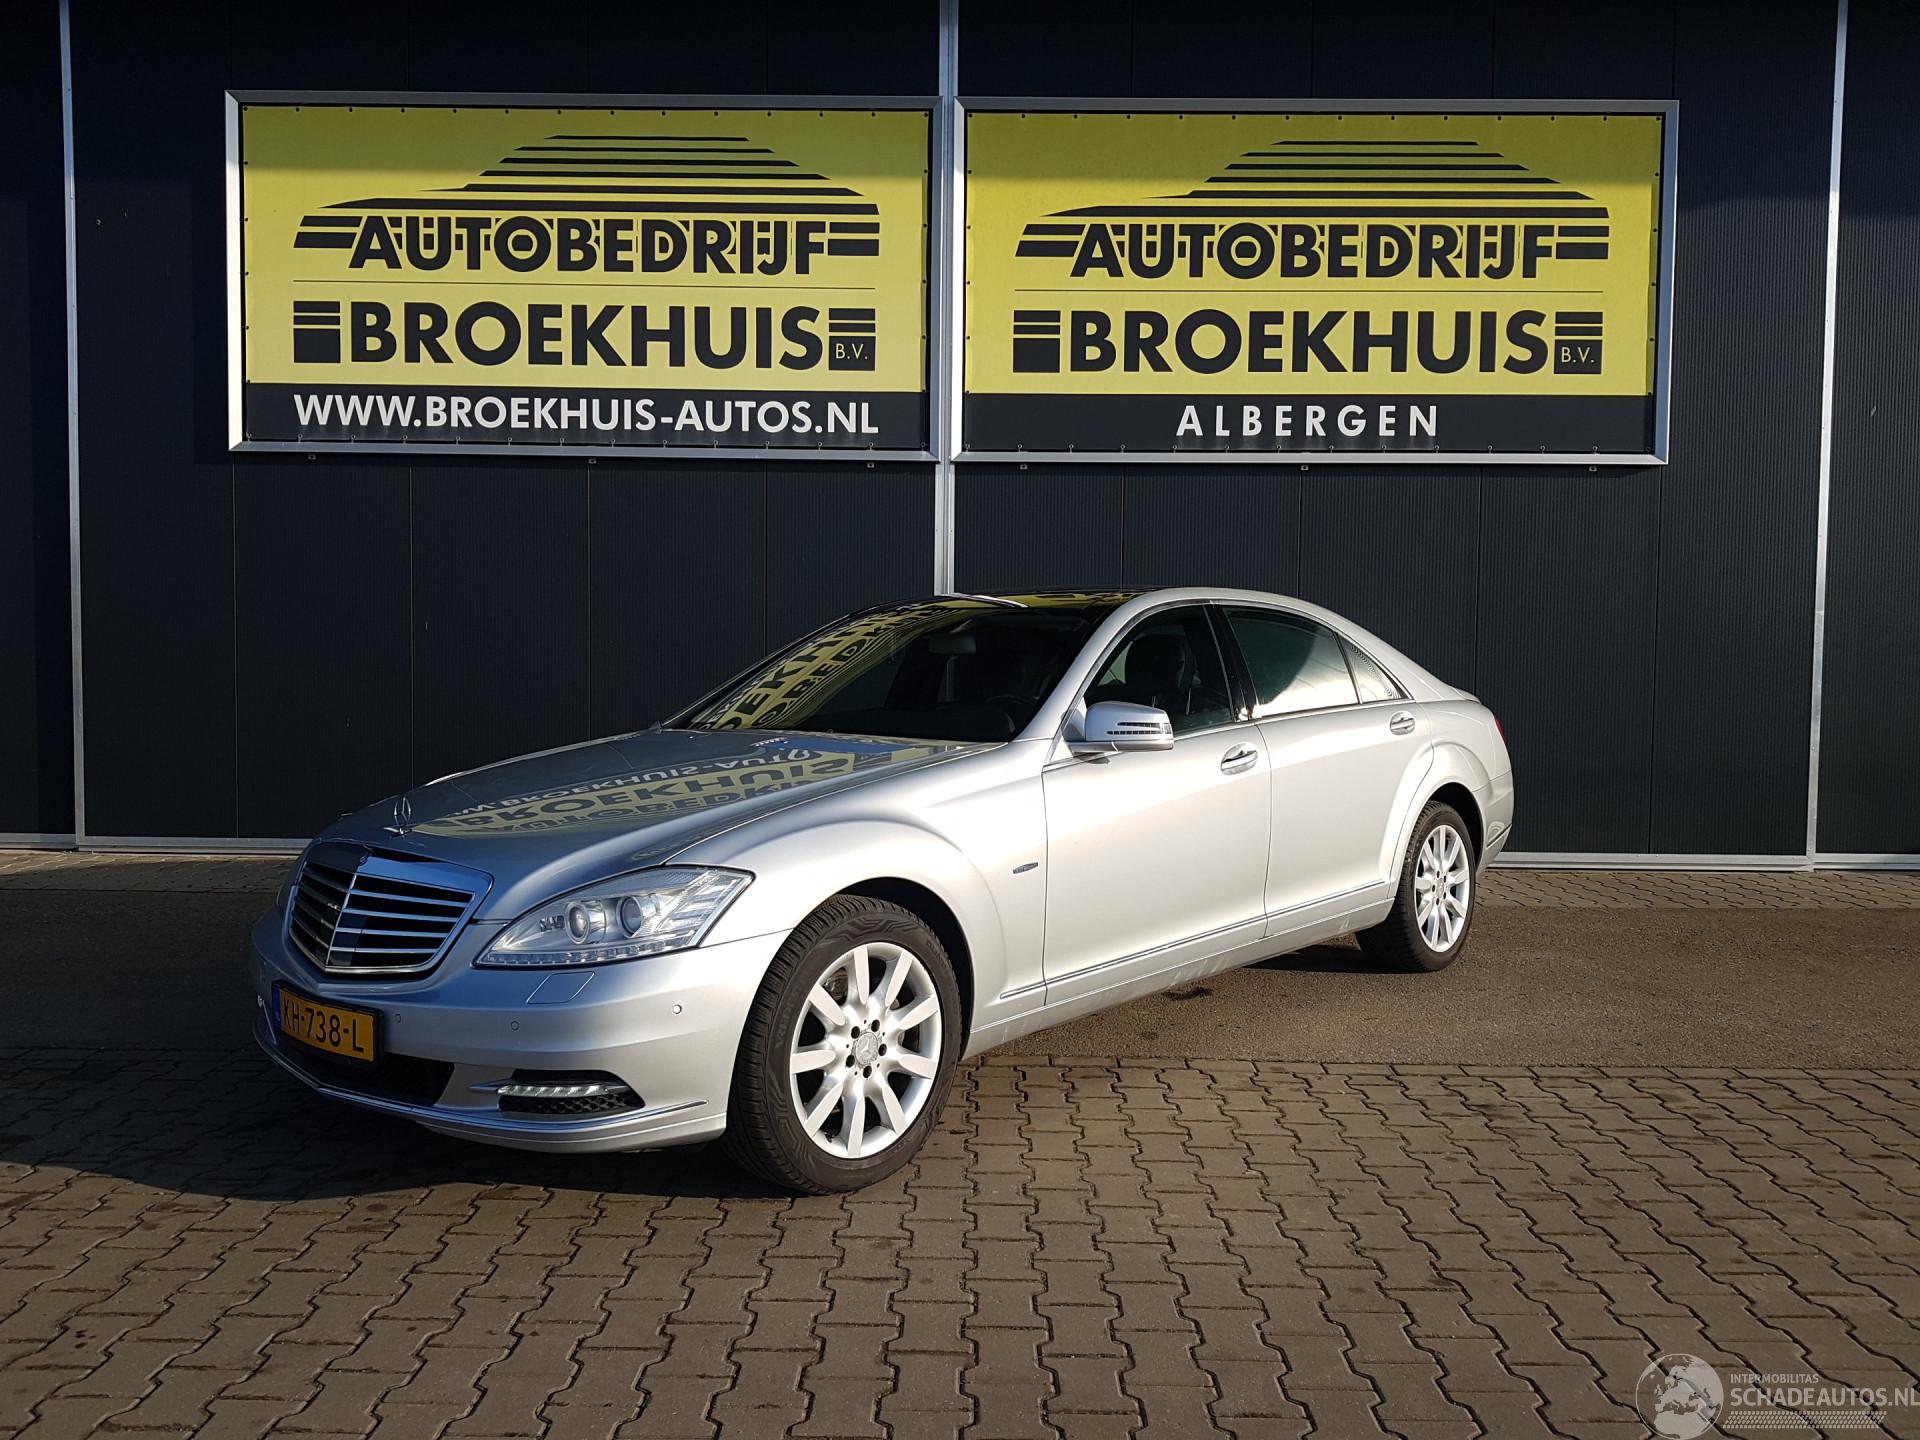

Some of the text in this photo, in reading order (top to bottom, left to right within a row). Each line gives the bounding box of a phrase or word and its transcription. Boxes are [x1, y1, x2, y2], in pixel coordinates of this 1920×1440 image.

[348, 215, 829, 276] AUTOBEDRIJF
[1070, 221, 1557, 280] AUTOBEDRIJF
[350, 301, 825, 370] BROEKHUIS
[835, 342, 869, 361] B.V.
[1069, 308, 1549, 375] BROEKHUIS
[1560, 345, 1595, 364] B.V.
[293, 394, 879, 435] WWW.BROEKHUIS-AUTOS.NL
[1176, 404, 1438, 438] ALBERGEN
[282, 994, 364, 1053] KH-738-L
